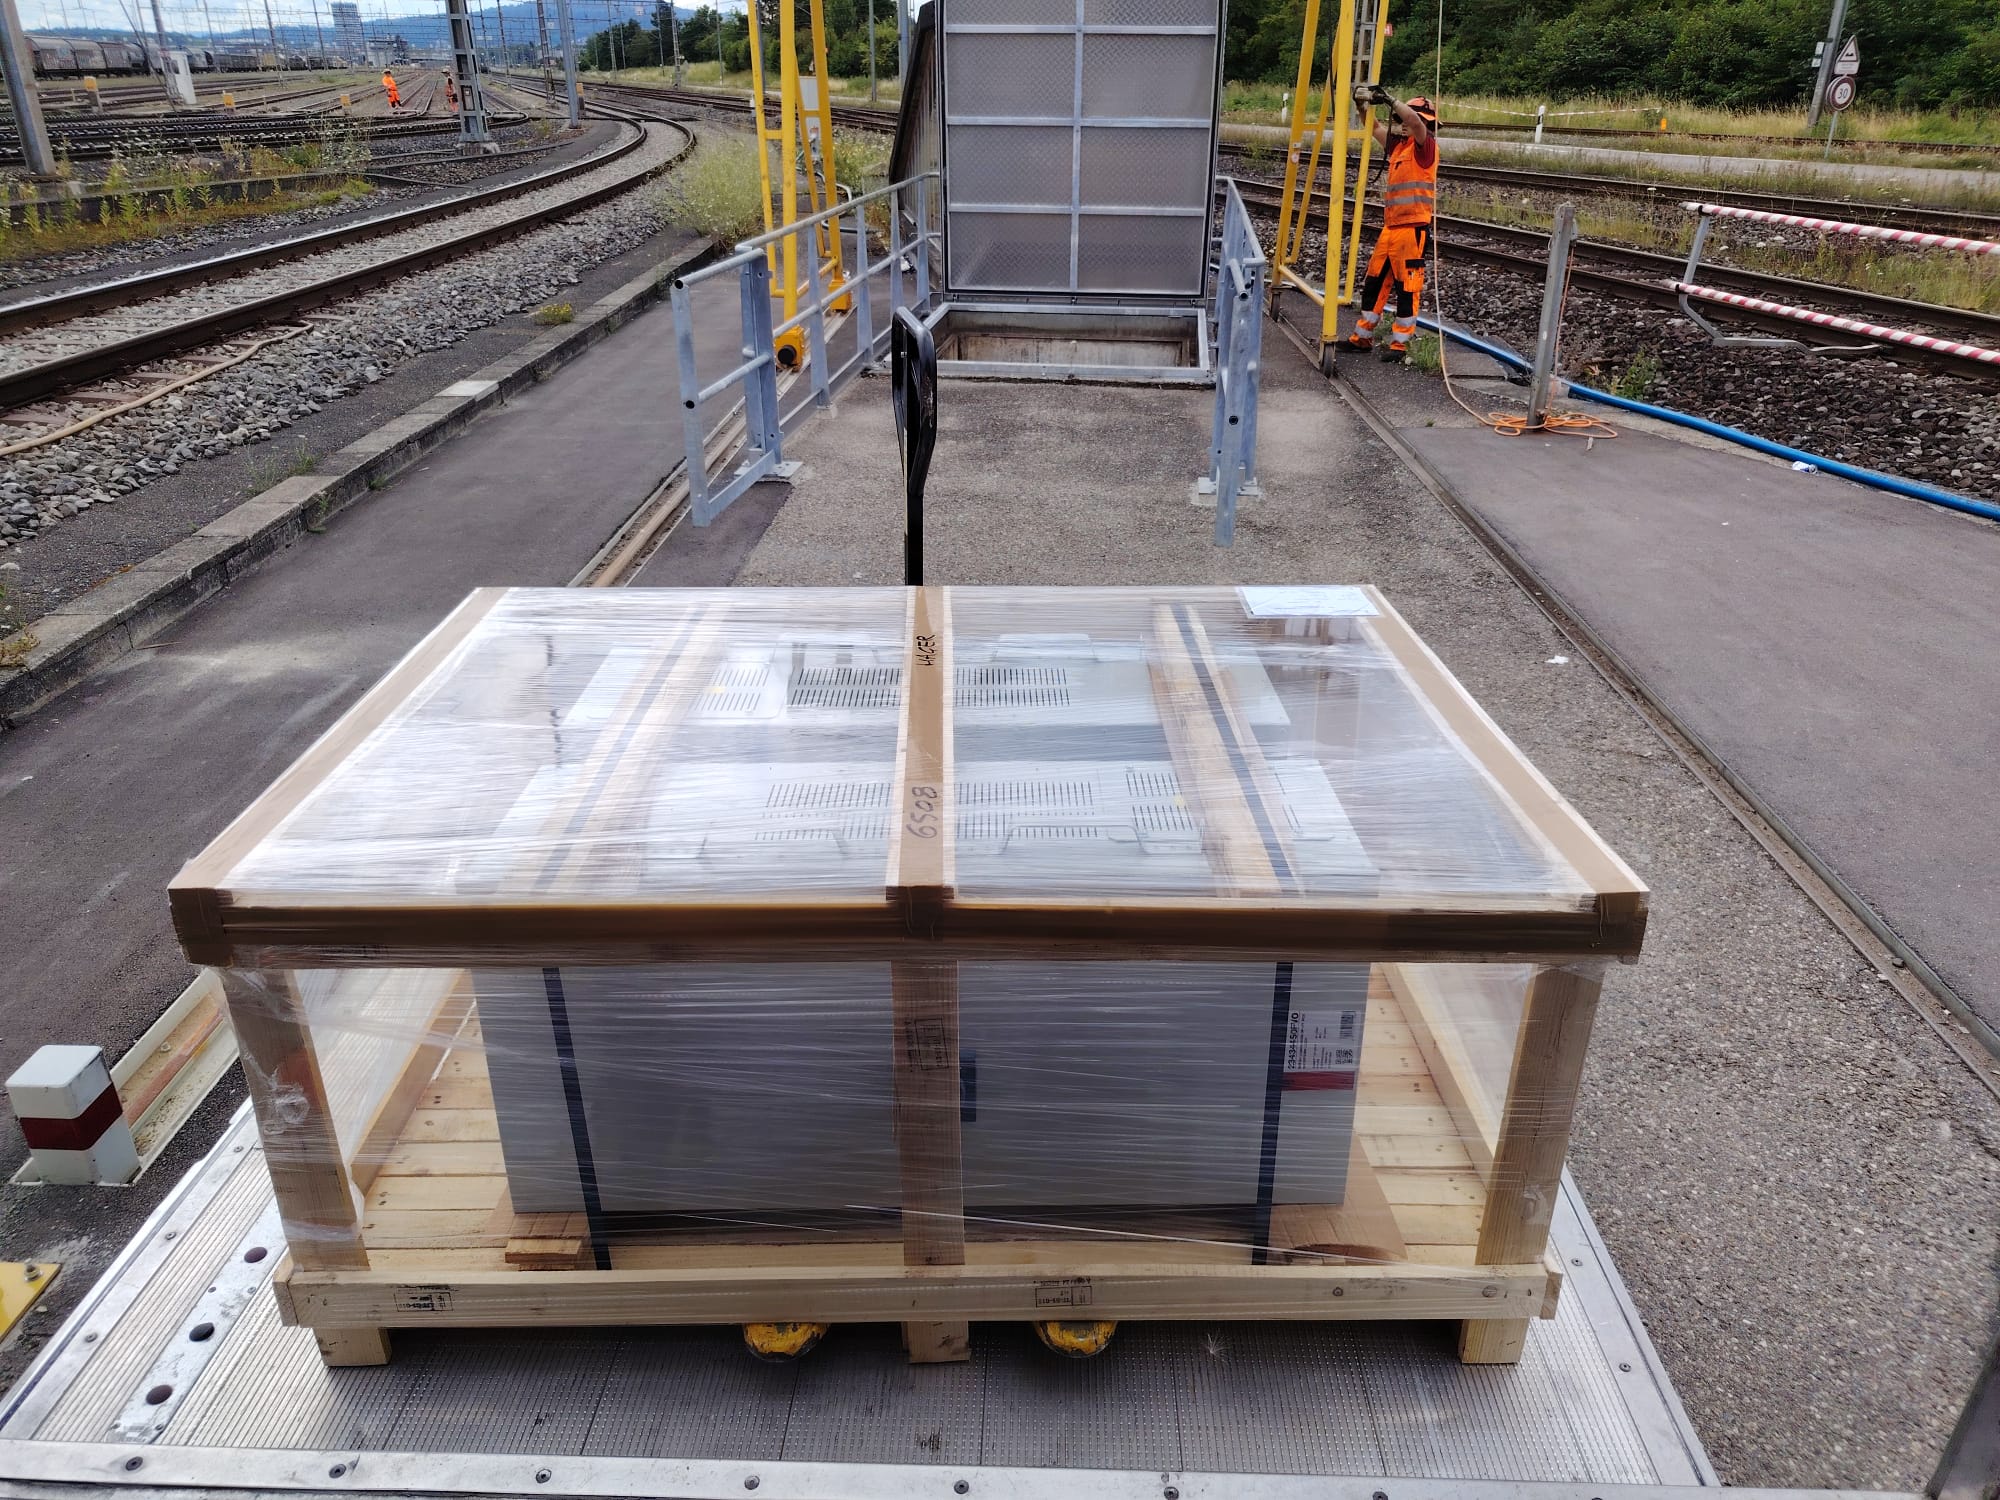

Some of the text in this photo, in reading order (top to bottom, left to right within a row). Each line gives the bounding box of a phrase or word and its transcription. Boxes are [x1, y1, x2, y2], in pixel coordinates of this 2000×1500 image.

[1838, 88, 1849, 99] 30
[915, 634, 936, 666] HAGER
[906, 787, 938, 838] 6508
